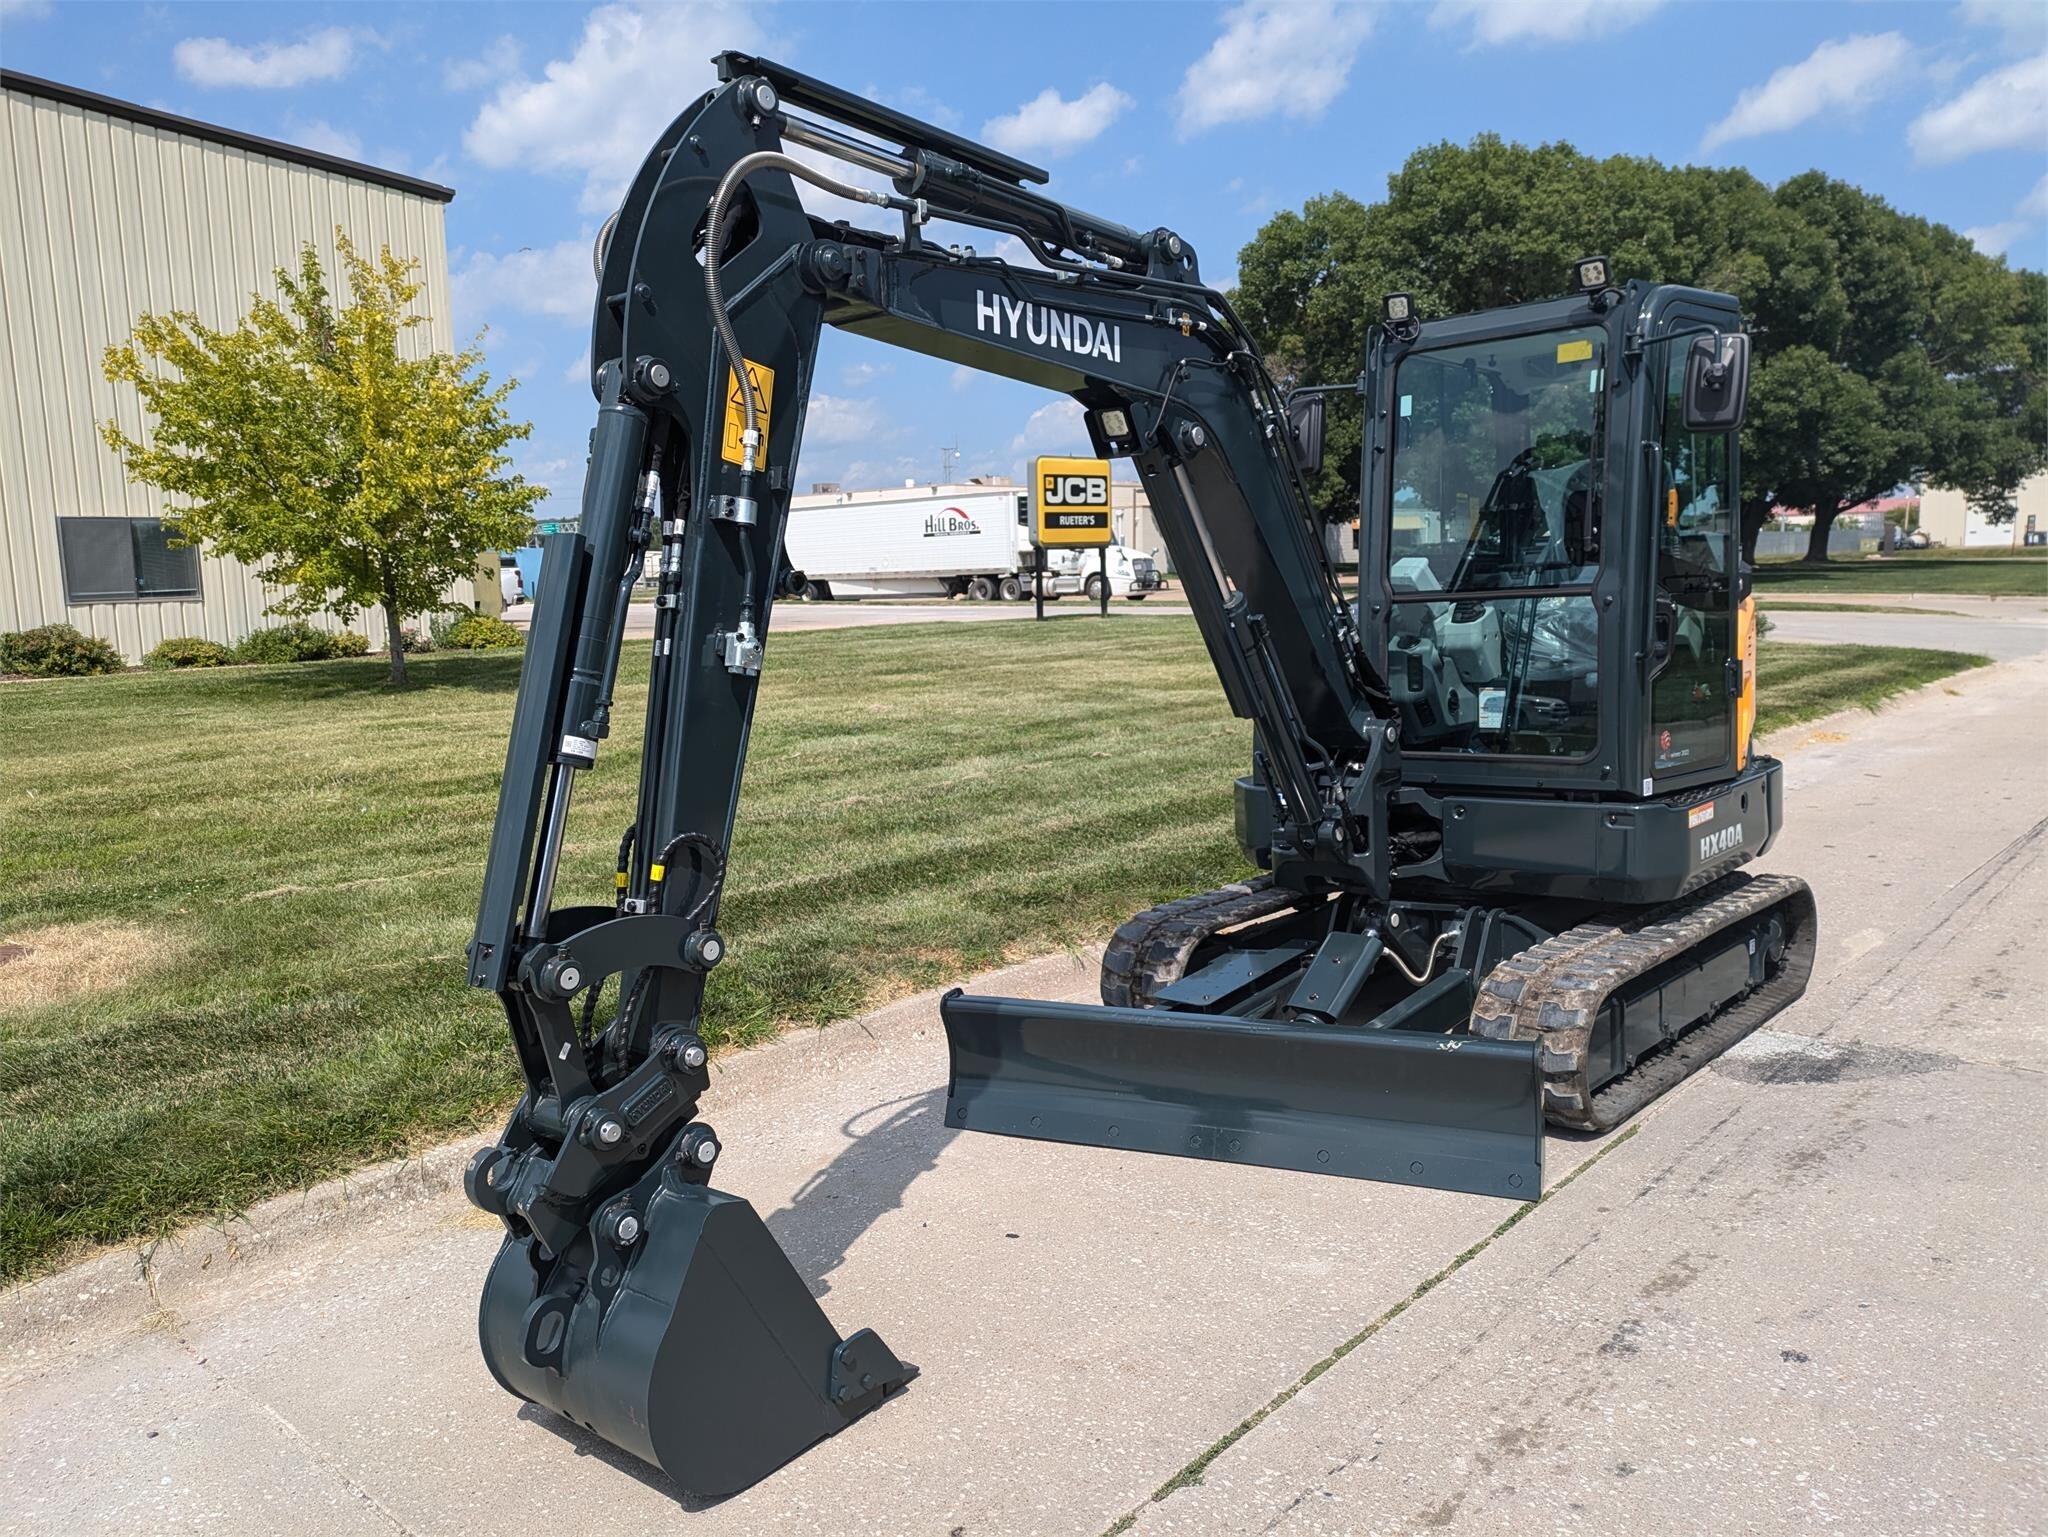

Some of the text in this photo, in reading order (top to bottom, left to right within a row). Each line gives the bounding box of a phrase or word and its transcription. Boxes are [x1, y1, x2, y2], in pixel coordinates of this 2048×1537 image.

[976, 289, 1121, 363] HYUNDAI
[1045, 476, 1107, 504] JCB
[1059, 515, 1095, 525] RUETER'S
[1700, 822, 1743, 860] HX40A
